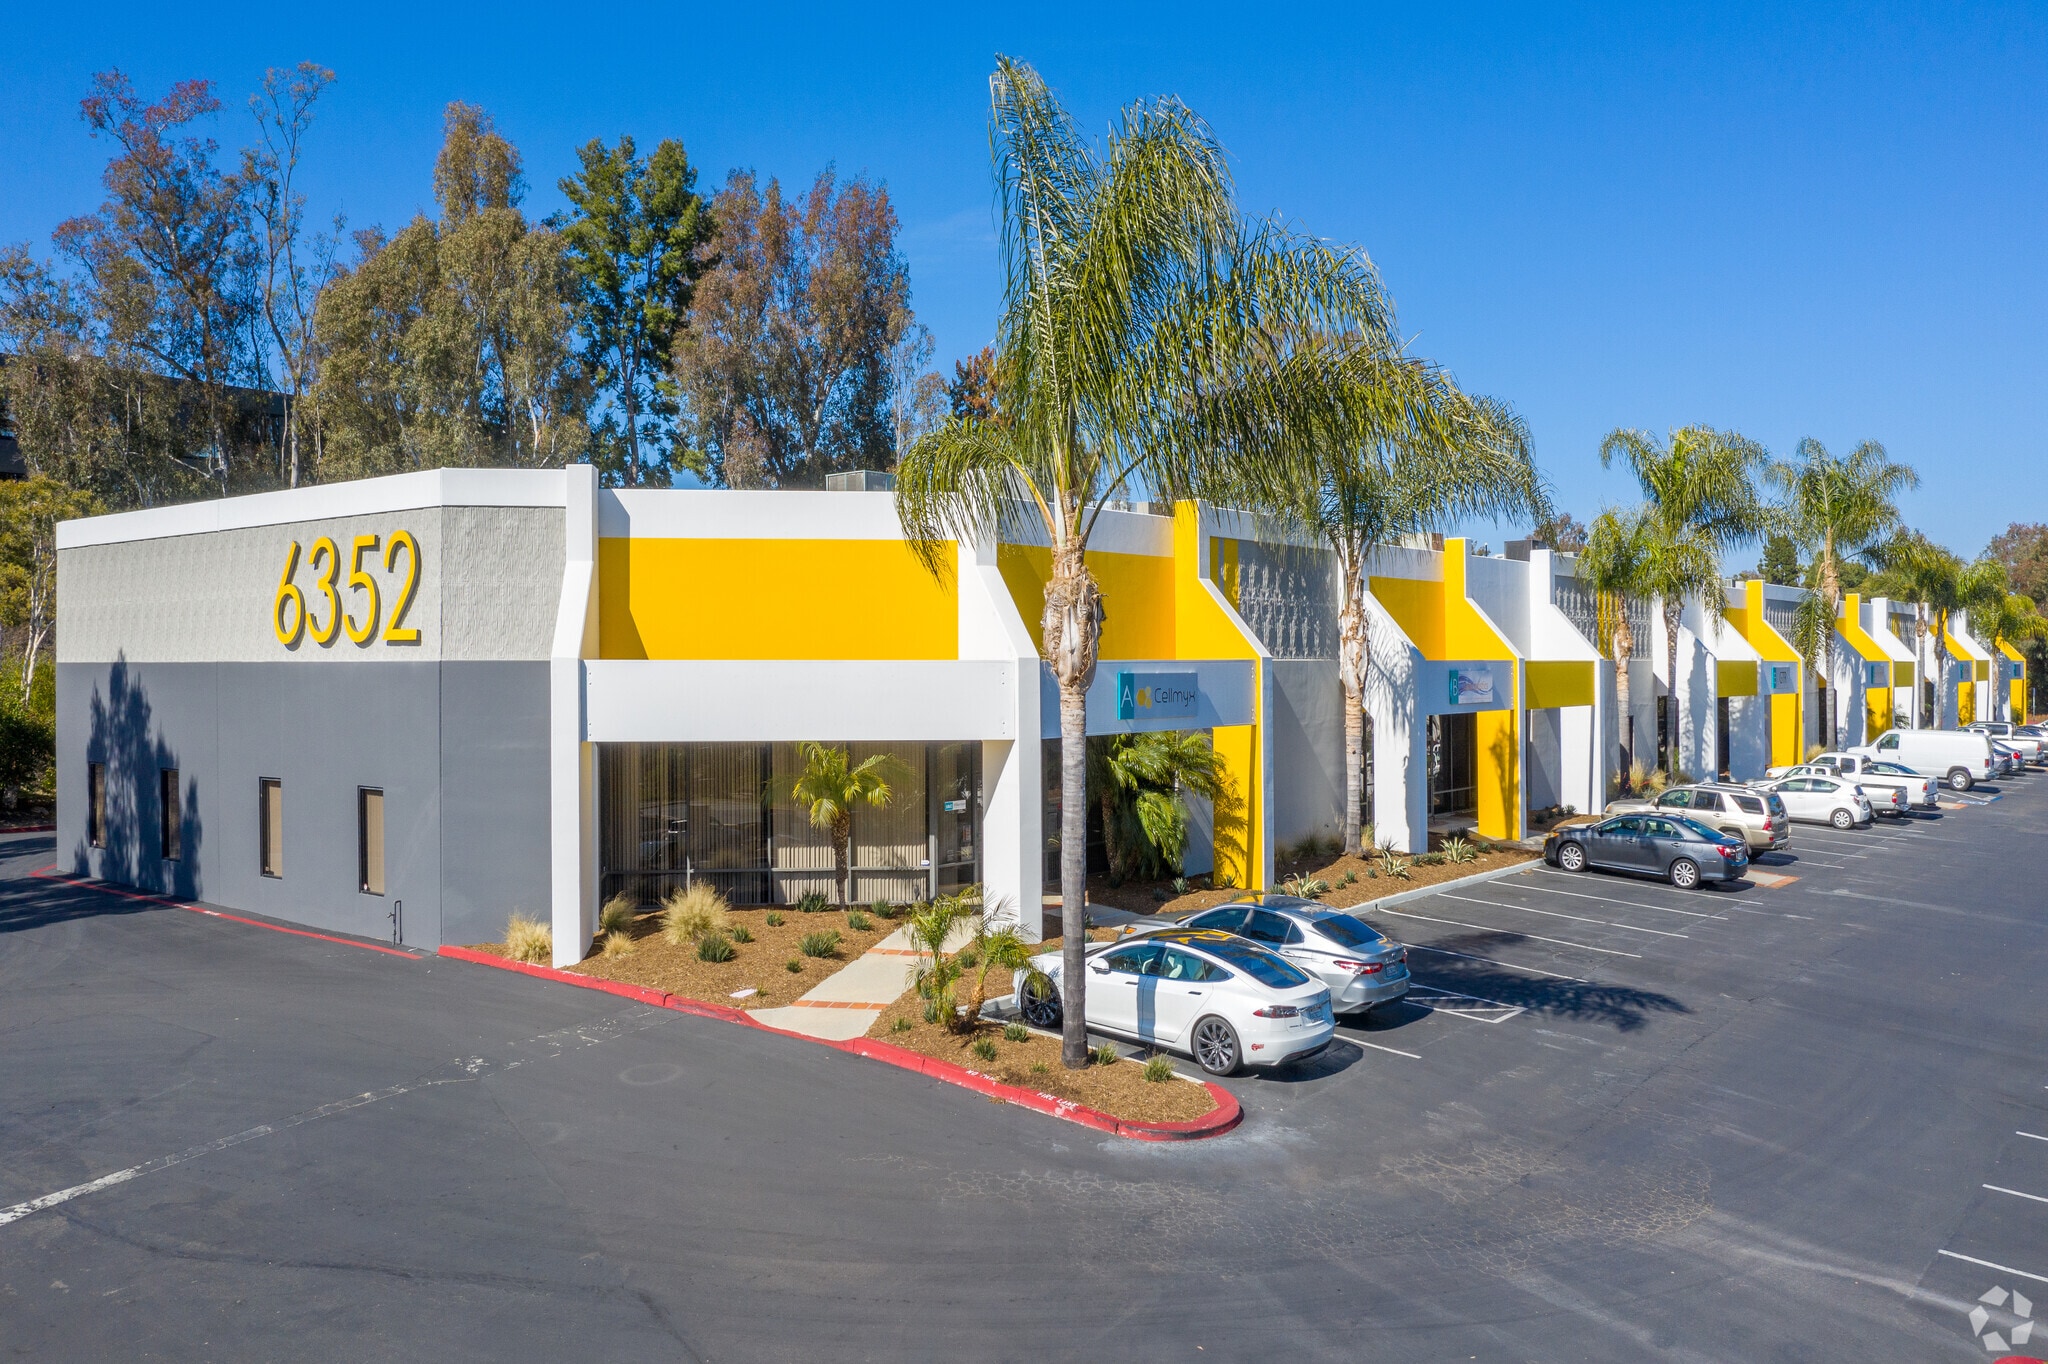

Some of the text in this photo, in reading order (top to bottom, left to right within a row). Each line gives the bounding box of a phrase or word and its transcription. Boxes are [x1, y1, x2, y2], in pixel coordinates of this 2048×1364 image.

[274, 529, 420, 648] 6352
[1121, 685, 1134, 708] A
[1154, 687, 1196, 707] Cellmyx
[1452, 678, 1458, 696] B
[1036, 1092, 1057, 1101] FIRE
